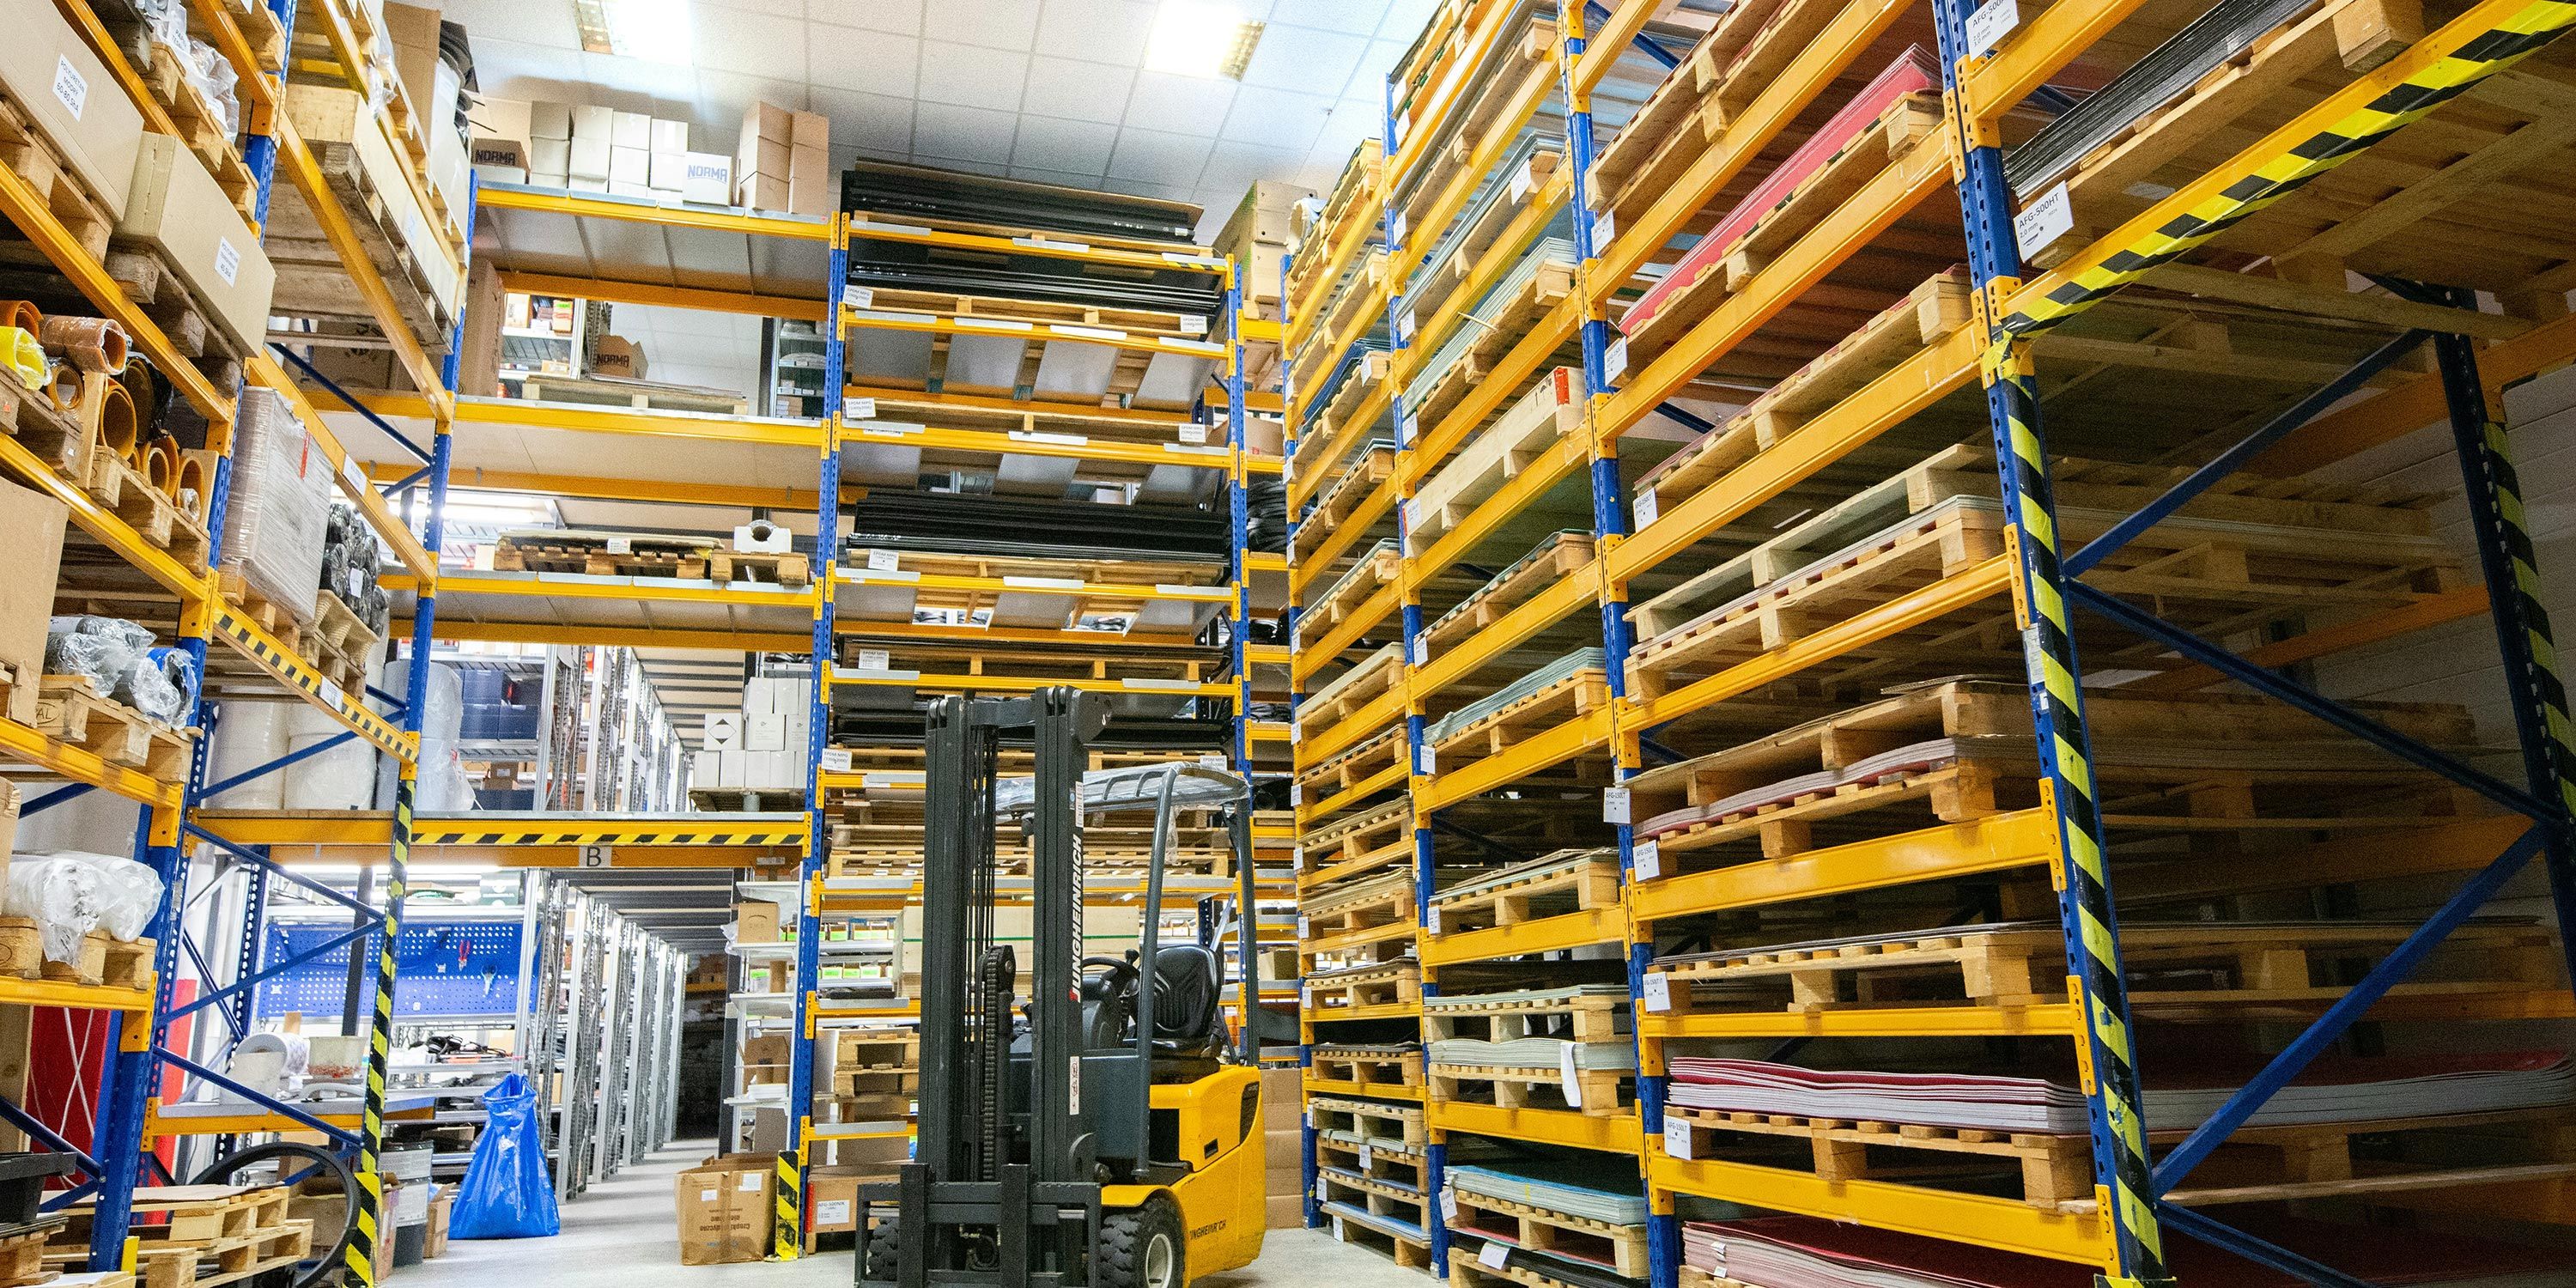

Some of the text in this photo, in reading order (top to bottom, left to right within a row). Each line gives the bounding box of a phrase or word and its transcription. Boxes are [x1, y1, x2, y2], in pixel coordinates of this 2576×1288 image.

[475, 149, 515, 166] NORMA
[687, 165, 728, 184] NORMA
[2019, 192, 2059, 228] AFG-500HT
[596, 354, 629, 368] NORMA
[586, 846, 602, 867] B
[1068, 834, 1082, 1003] JUNGHEINRICH
